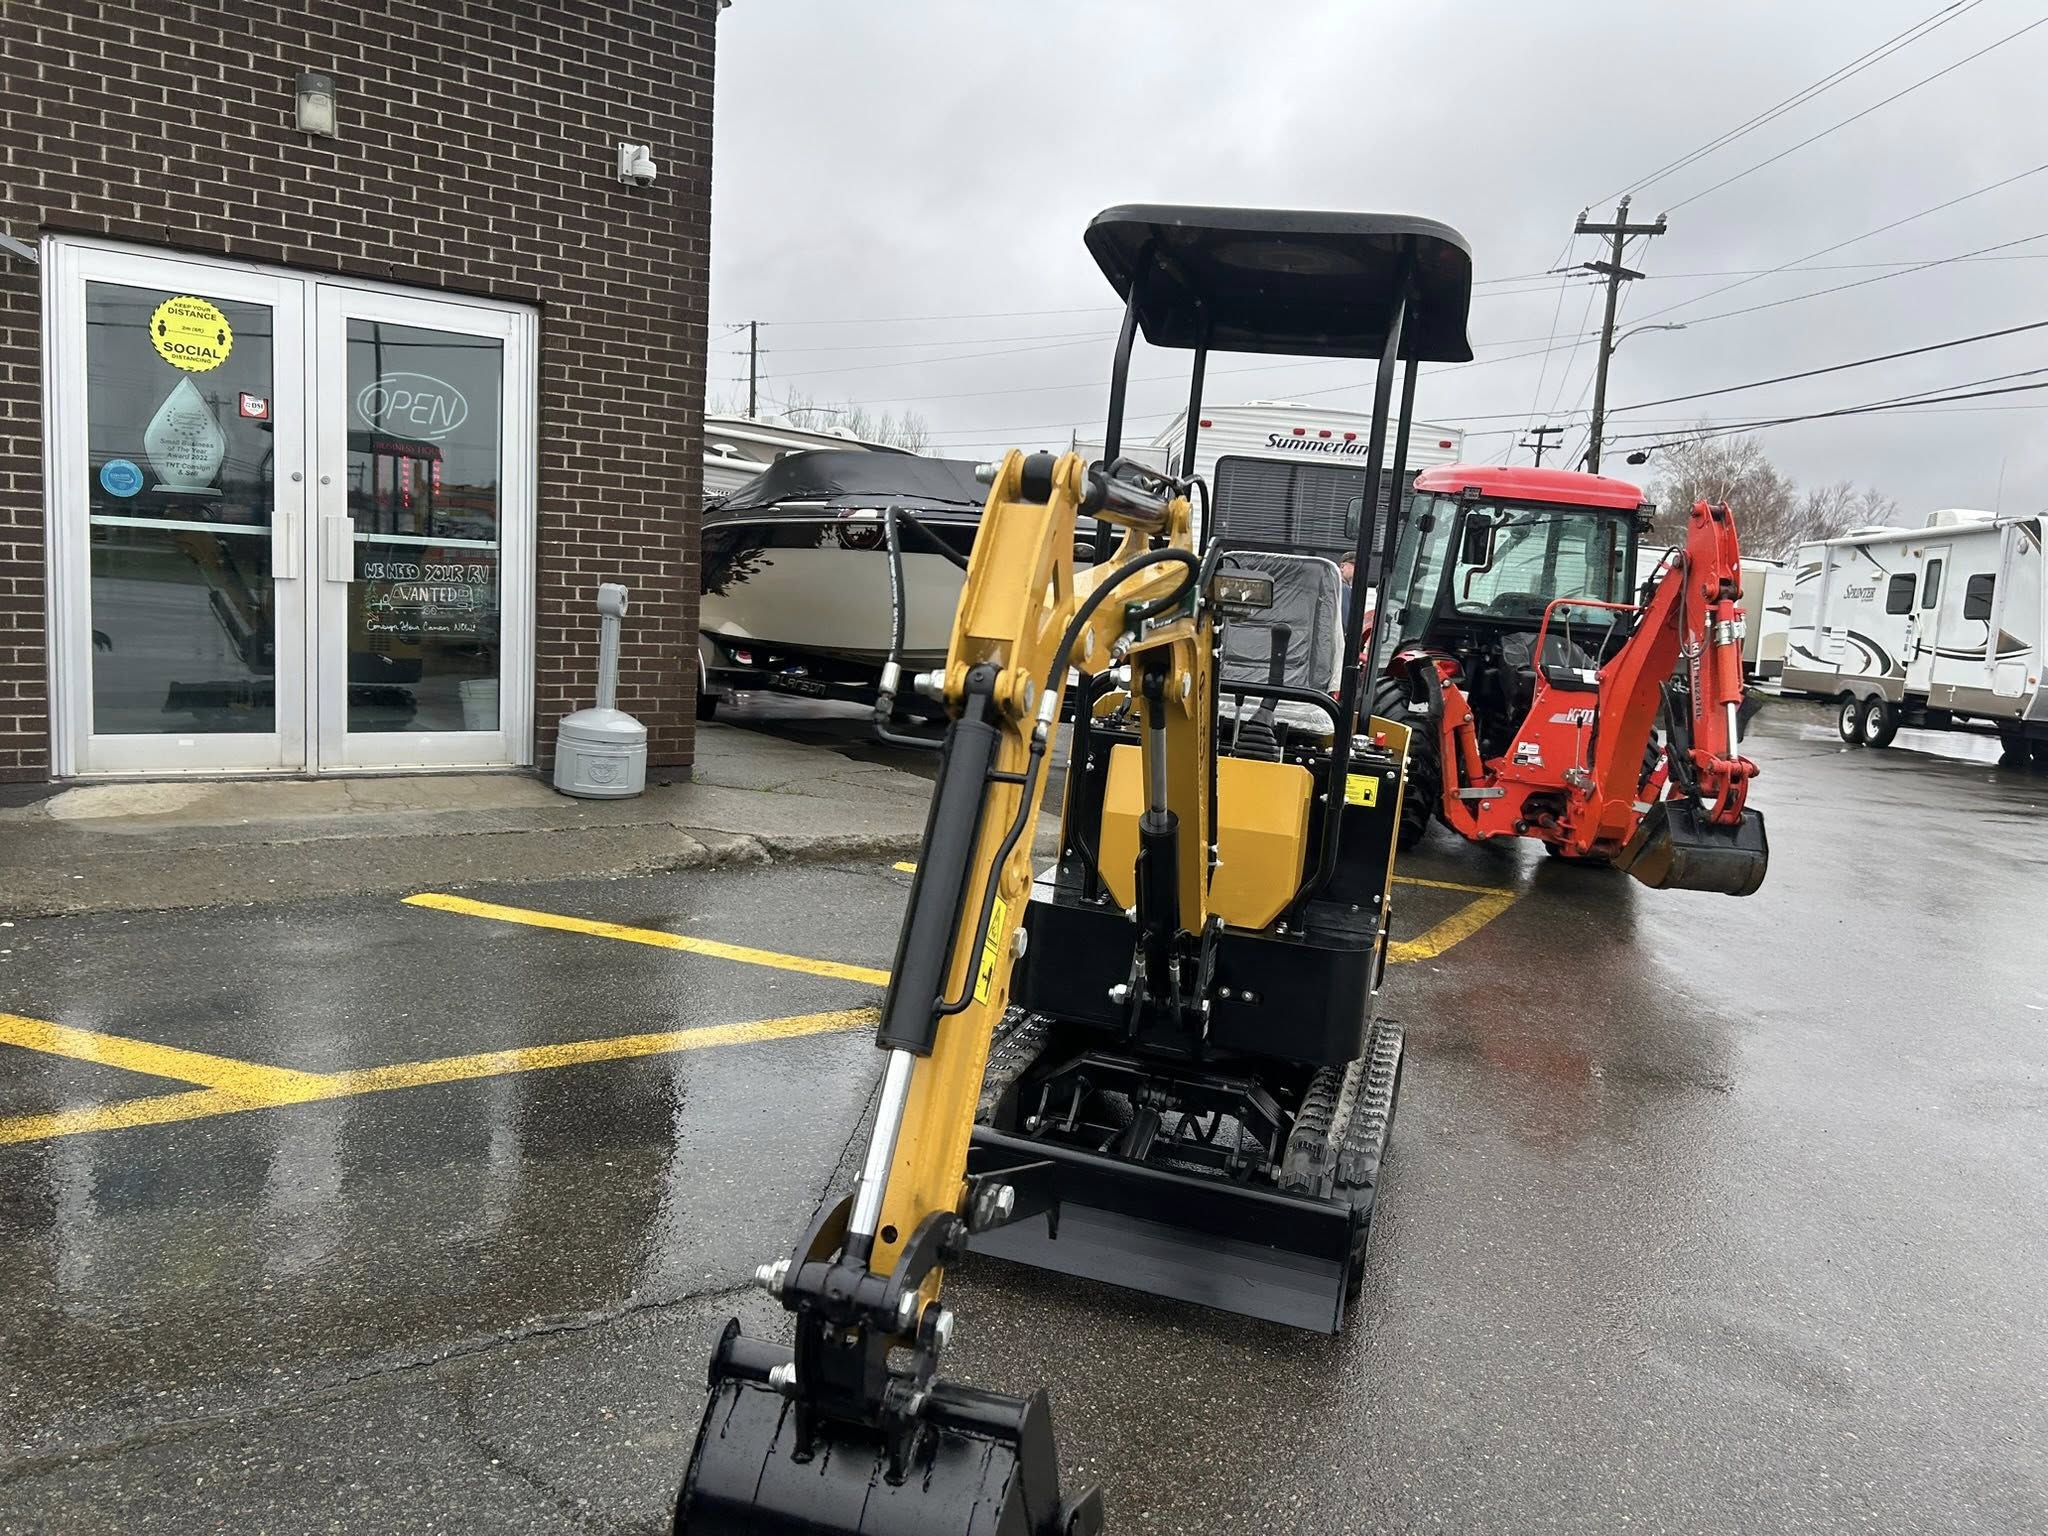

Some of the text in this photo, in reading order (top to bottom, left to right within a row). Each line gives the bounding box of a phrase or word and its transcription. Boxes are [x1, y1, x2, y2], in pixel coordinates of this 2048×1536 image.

[167, 307, 217, 321] DISTANCE
[163, 341, 221, 359] SOCIAL
[171, 353, 212, 364] DISTANCING
[364, 387, 458, 427] OPEN
[1265, 433, 1369, 455] Summerlan
[365, 562, 489, 584] WE NEED YOUR RV
[399, 587, 457, 602] WANTED
